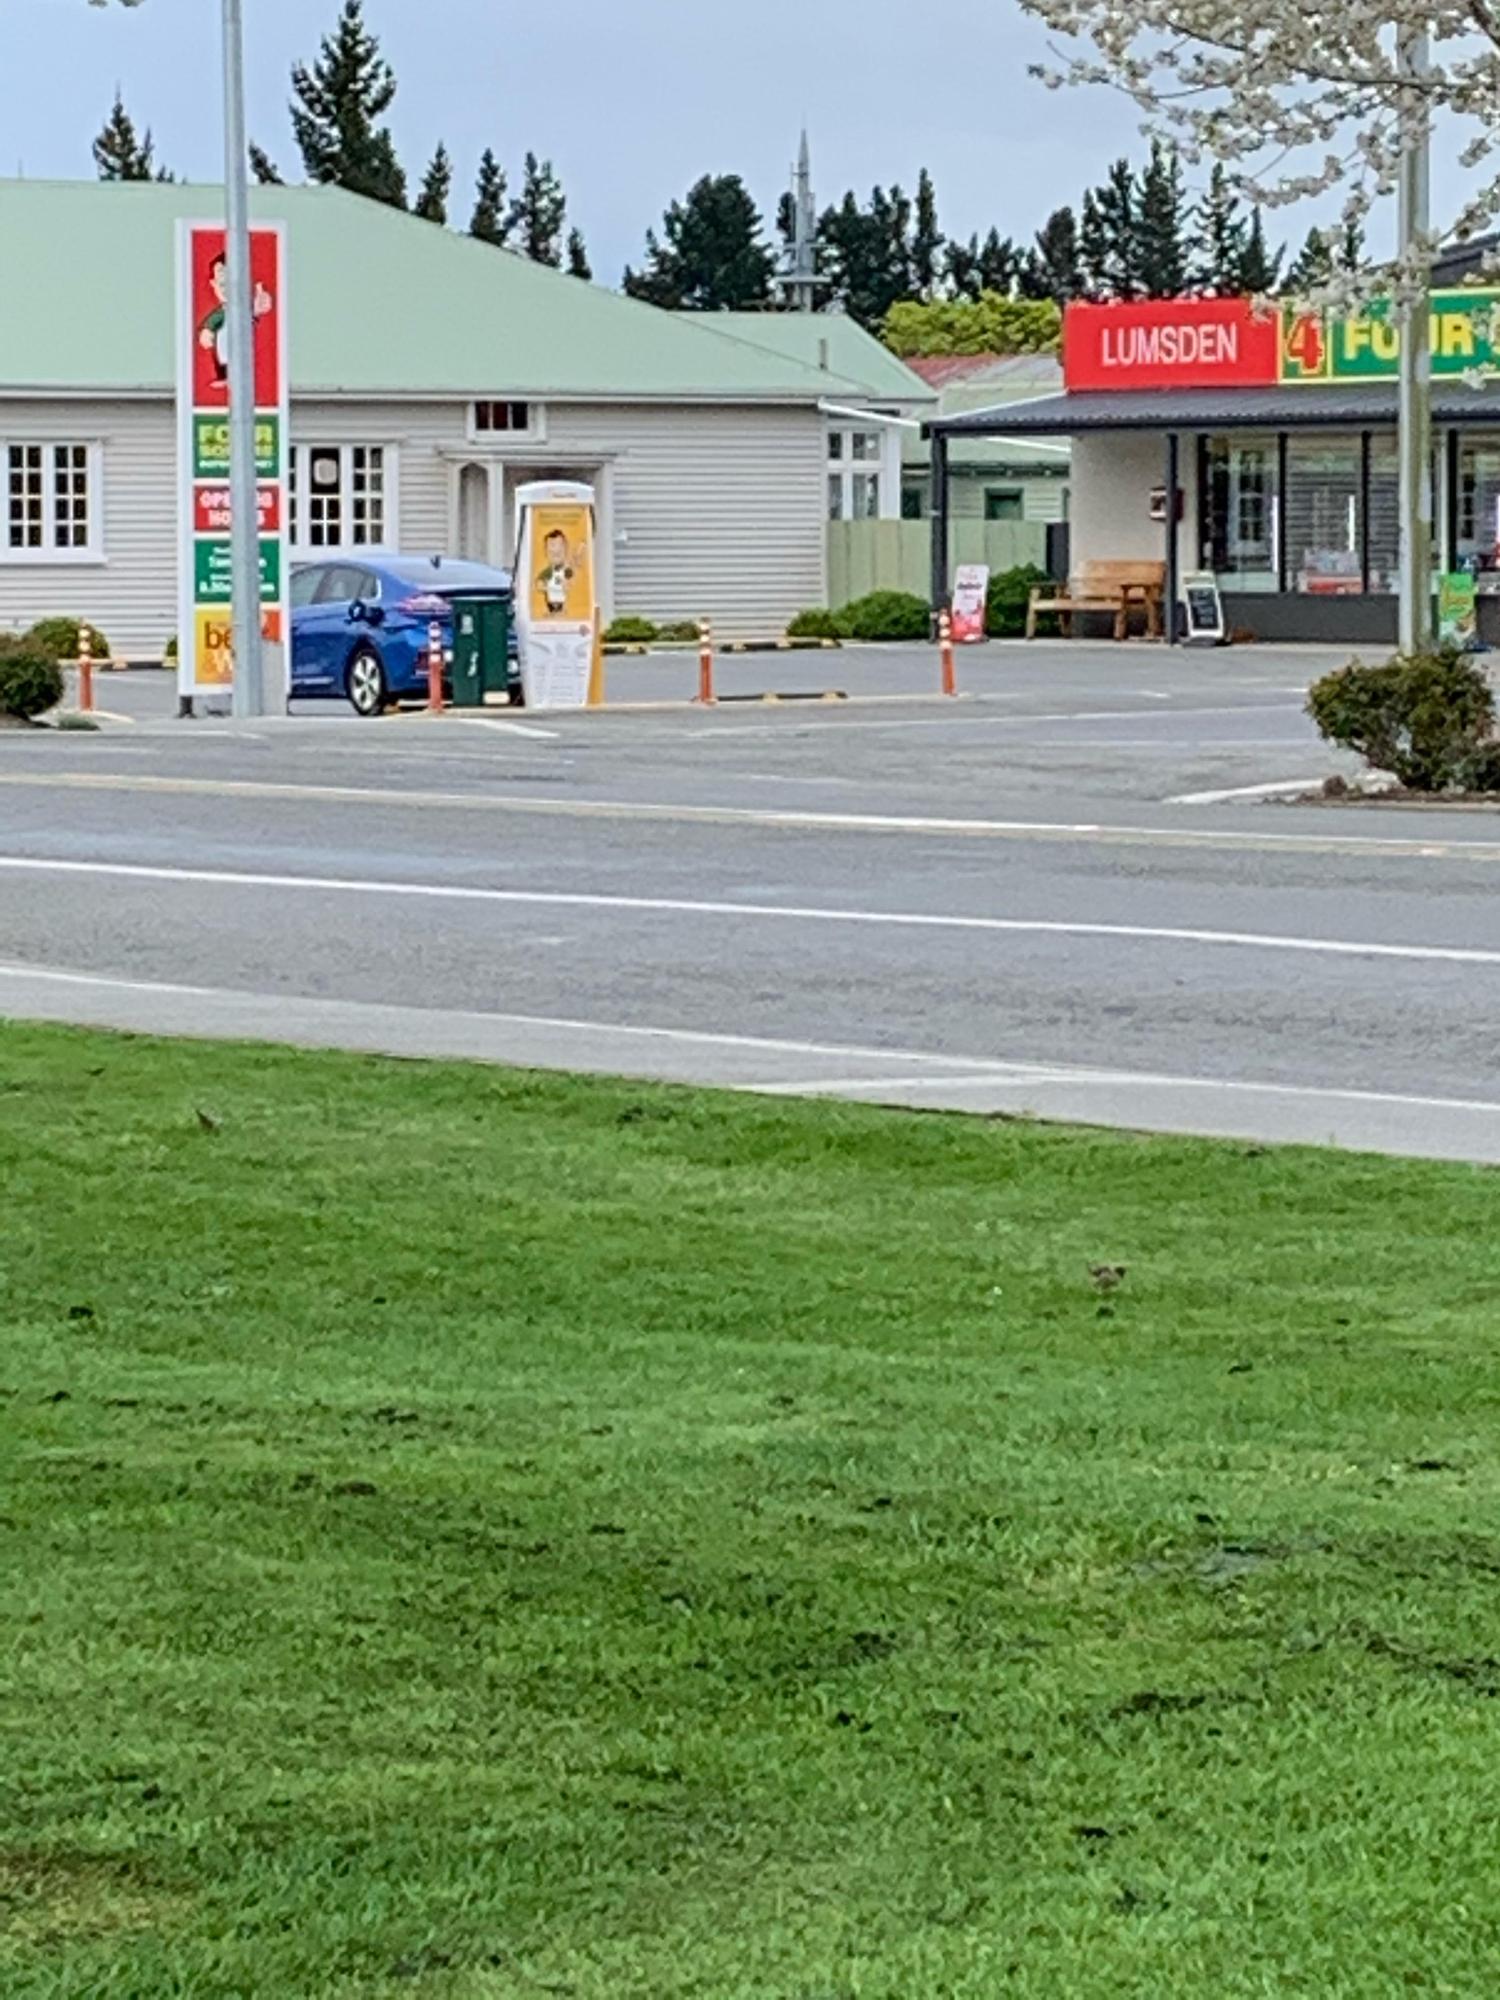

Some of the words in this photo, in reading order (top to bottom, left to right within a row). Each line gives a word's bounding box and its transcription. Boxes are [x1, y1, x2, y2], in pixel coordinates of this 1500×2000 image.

[1102, 322, 1238, 366] LUMSDEN
[1288, 314, 1323, 374] 4
[199, 425, 273, 443] FOR
[208, 510, 265, 526] HOS
